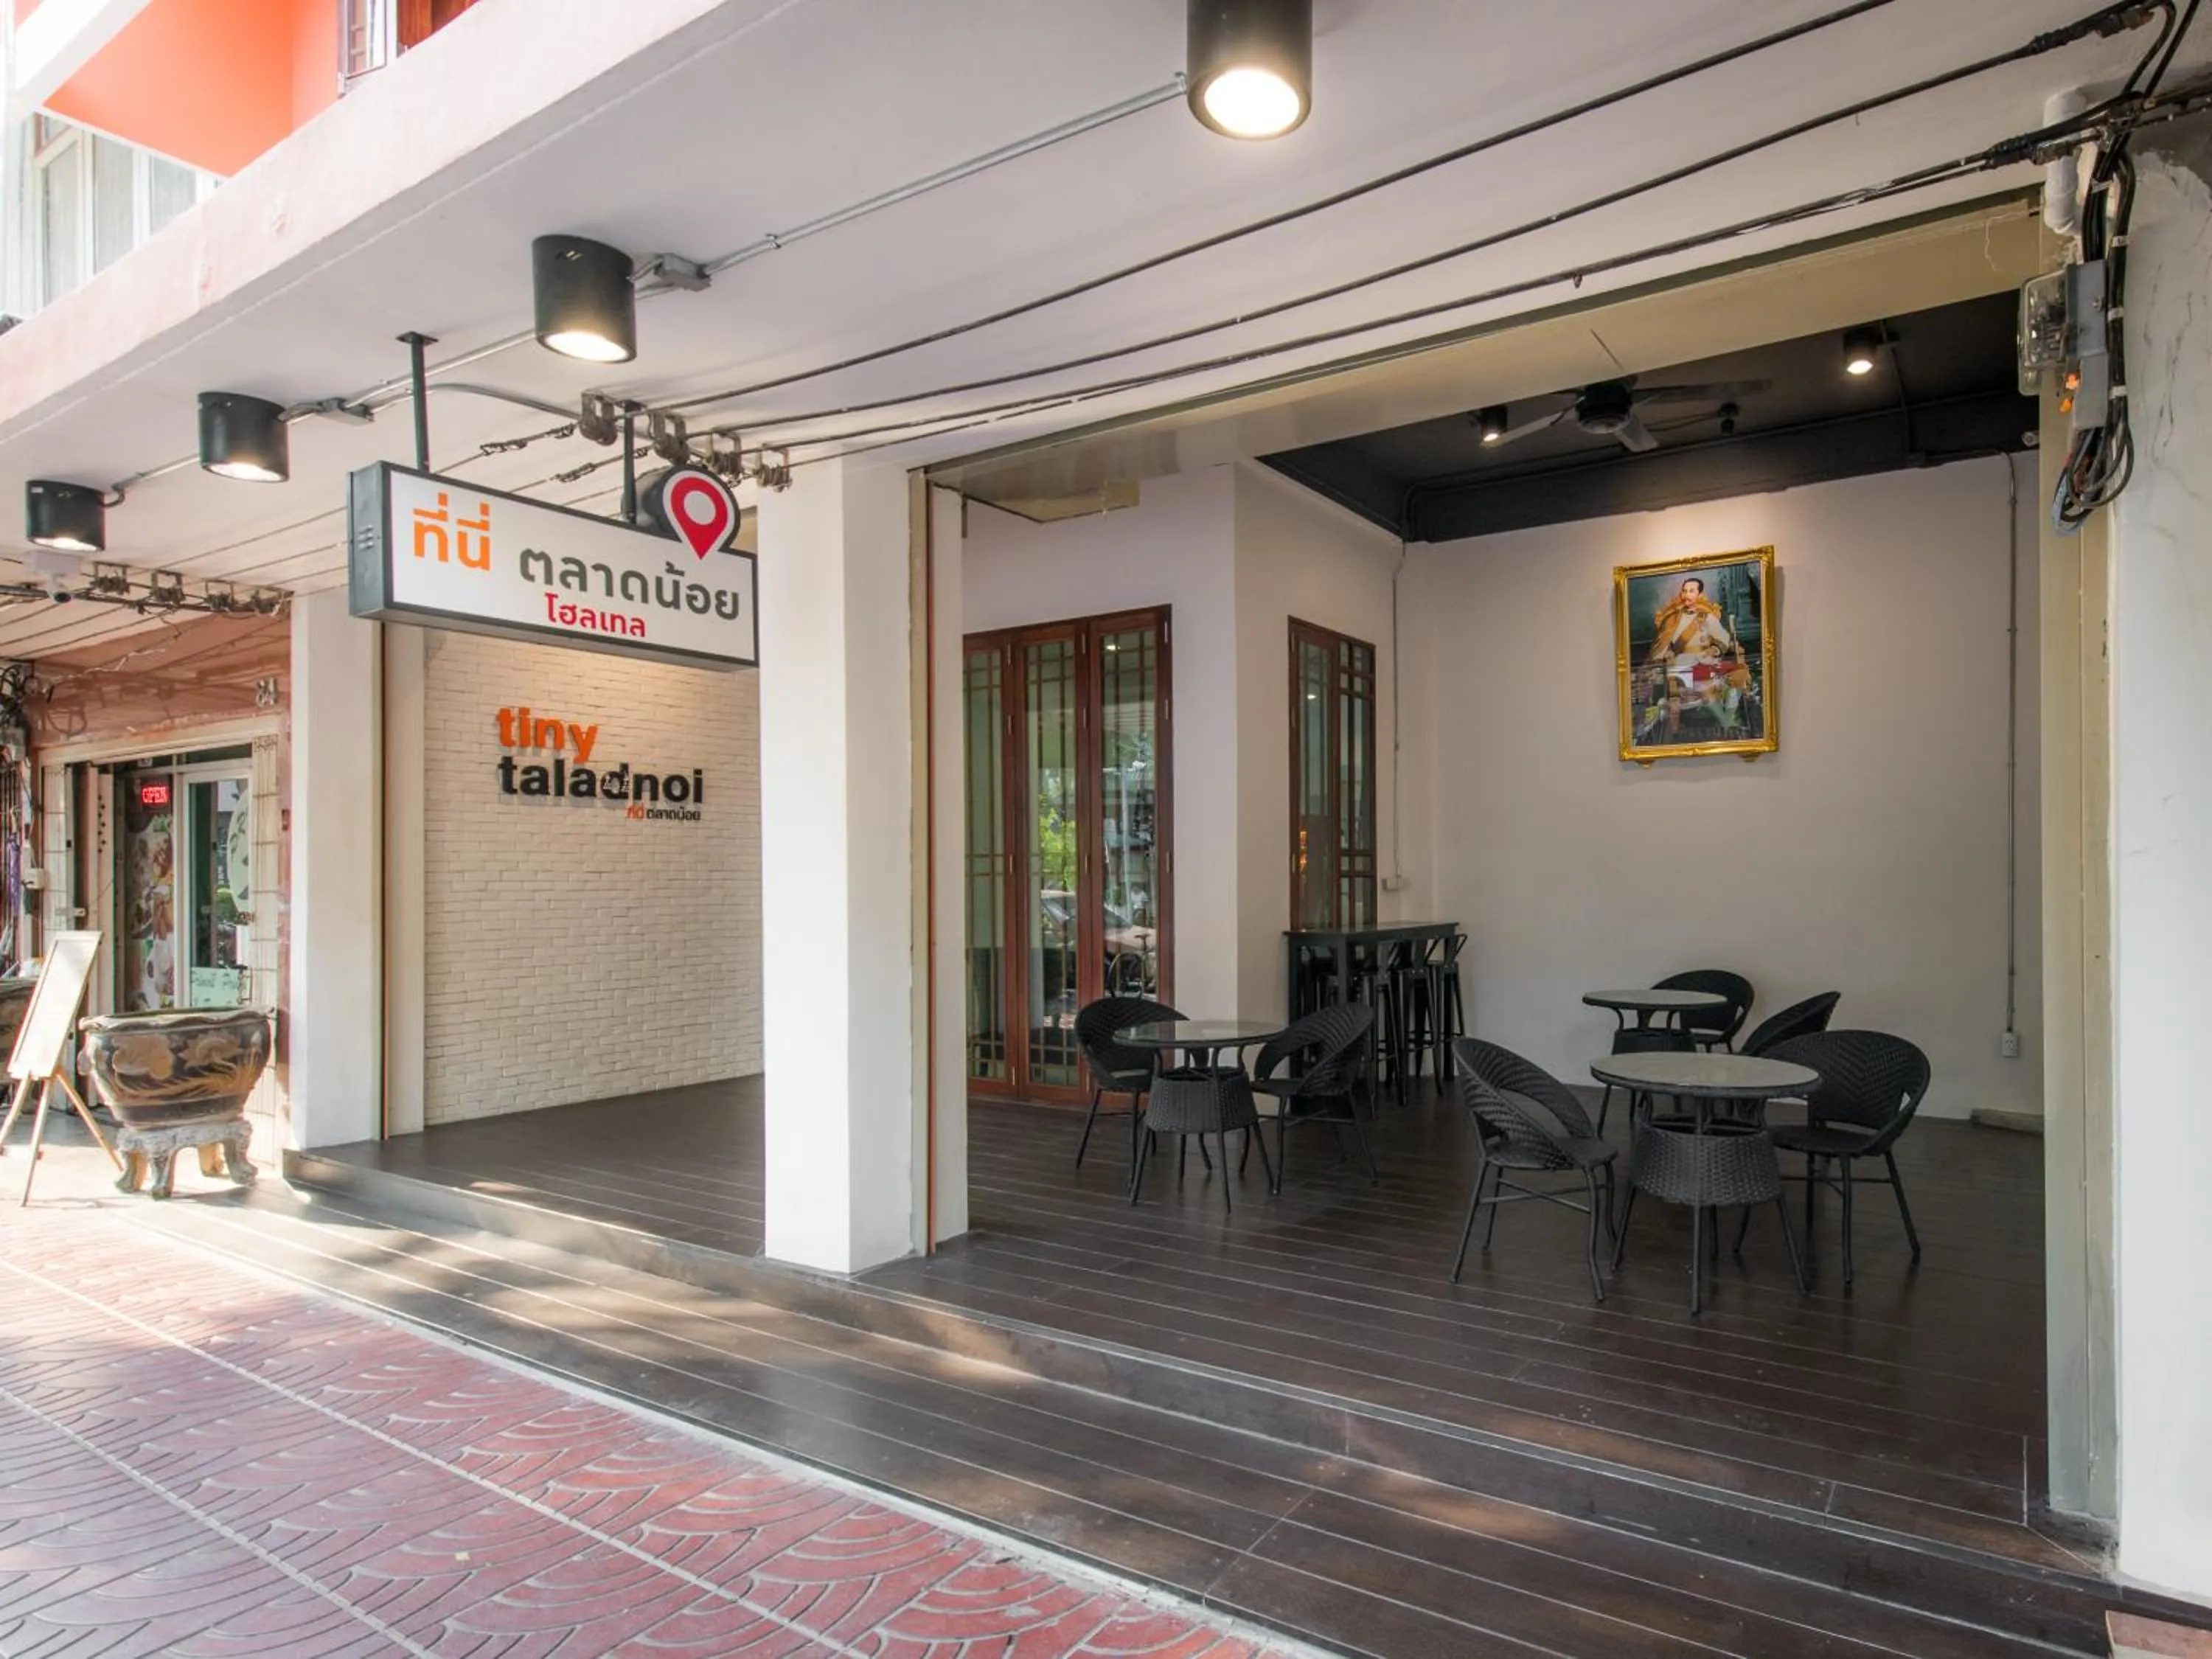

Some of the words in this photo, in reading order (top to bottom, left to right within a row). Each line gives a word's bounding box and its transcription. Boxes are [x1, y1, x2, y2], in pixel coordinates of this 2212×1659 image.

[413, 492, 490, 571] ที่นี่
[519, 548, 740, 621] ตลาดน้อย
[496, 707, 599, 764] tiny
[142, 786, 168, 804] OPEN
[498, 755, 703, 803] taladnoi
